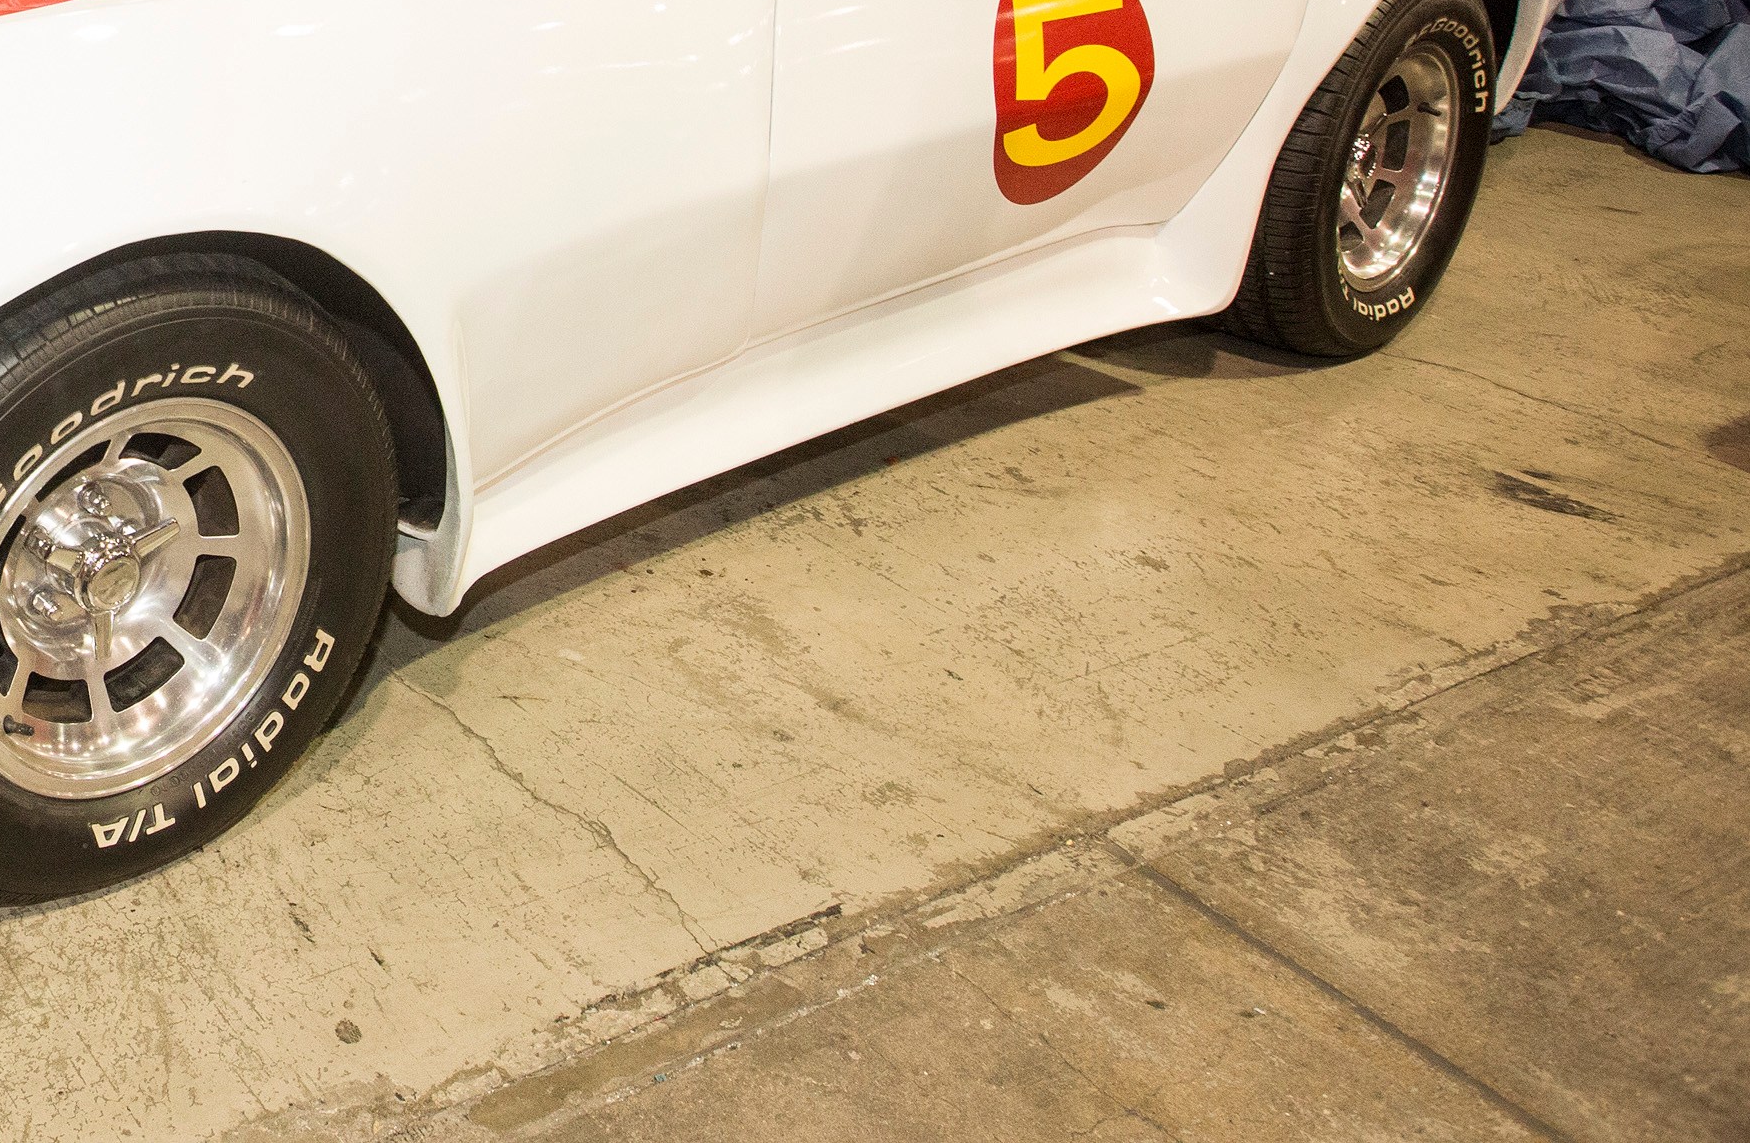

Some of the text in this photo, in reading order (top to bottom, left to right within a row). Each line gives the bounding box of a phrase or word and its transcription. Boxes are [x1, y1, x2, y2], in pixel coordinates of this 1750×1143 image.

[1353, 286, 1416, 322] Radial
[194, 628, 336, 809] Radial
[90, 801, 176, 849] T/A
